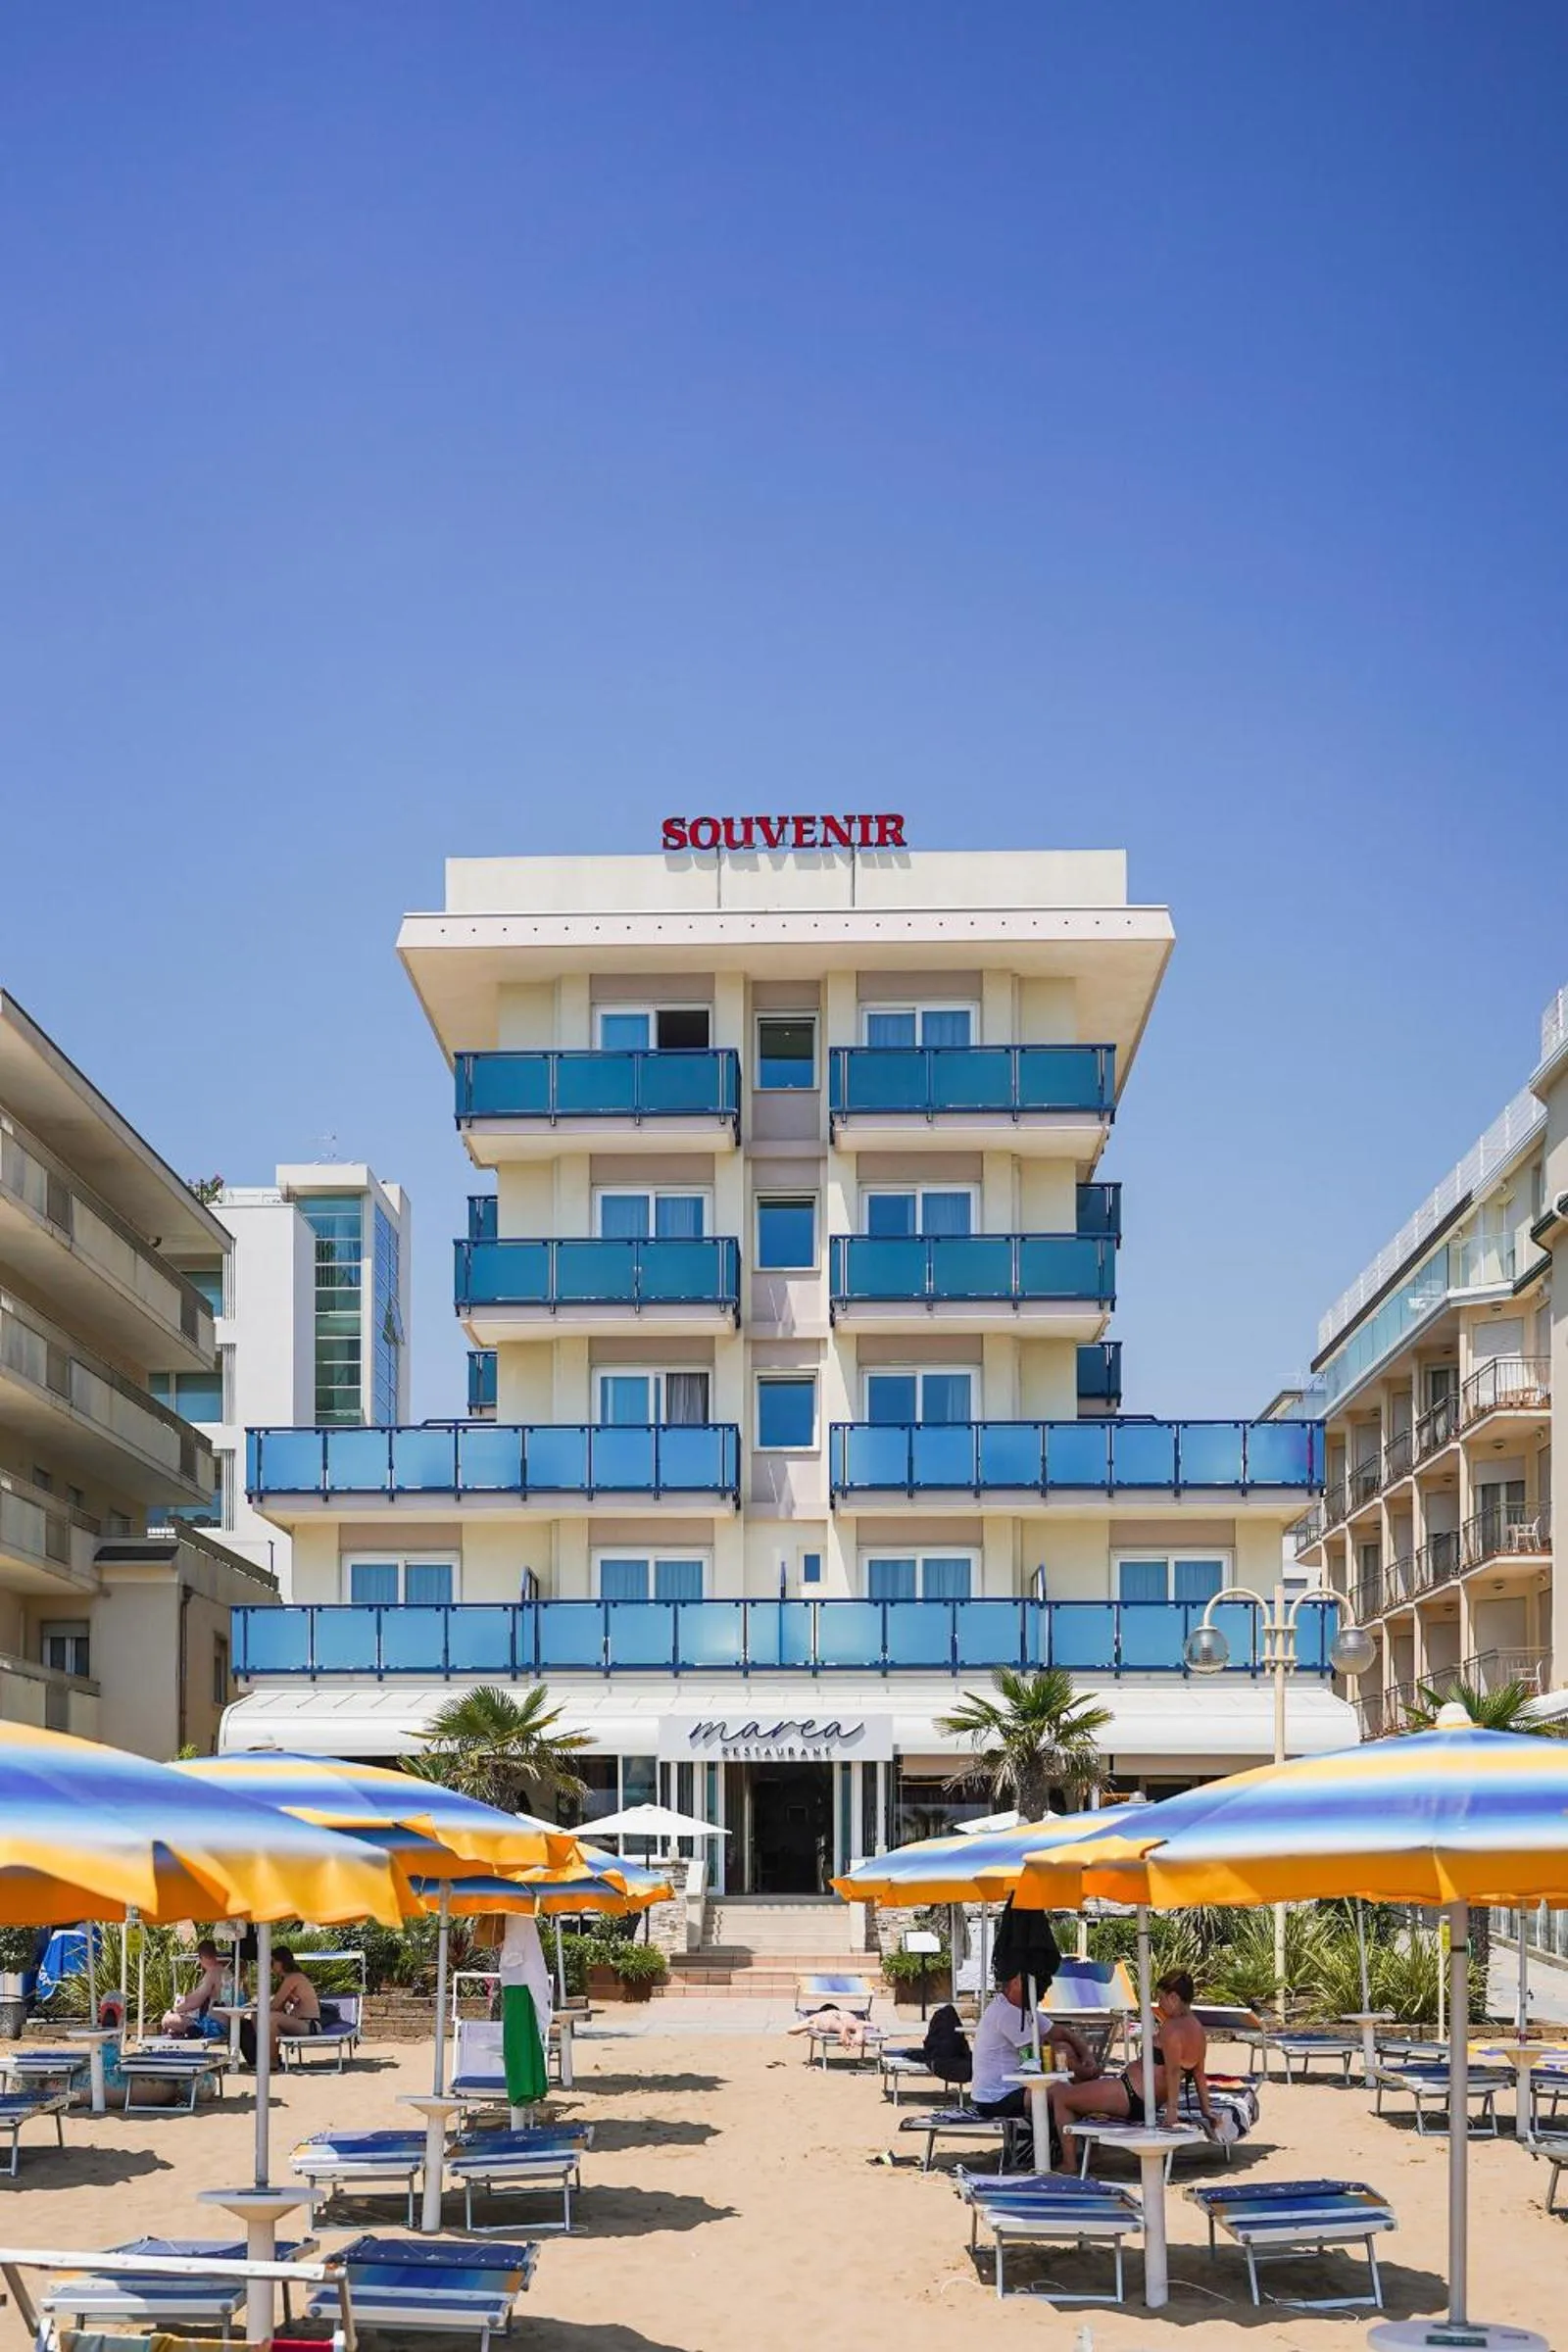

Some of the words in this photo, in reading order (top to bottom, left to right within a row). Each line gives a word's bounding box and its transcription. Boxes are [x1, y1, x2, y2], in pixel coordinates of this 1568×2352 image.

[662, 813, 907, 850] SOUVENIR
[689, 1719, 864, 1741] marea
[721, 1746, 832, 1758] RESTAURANT
